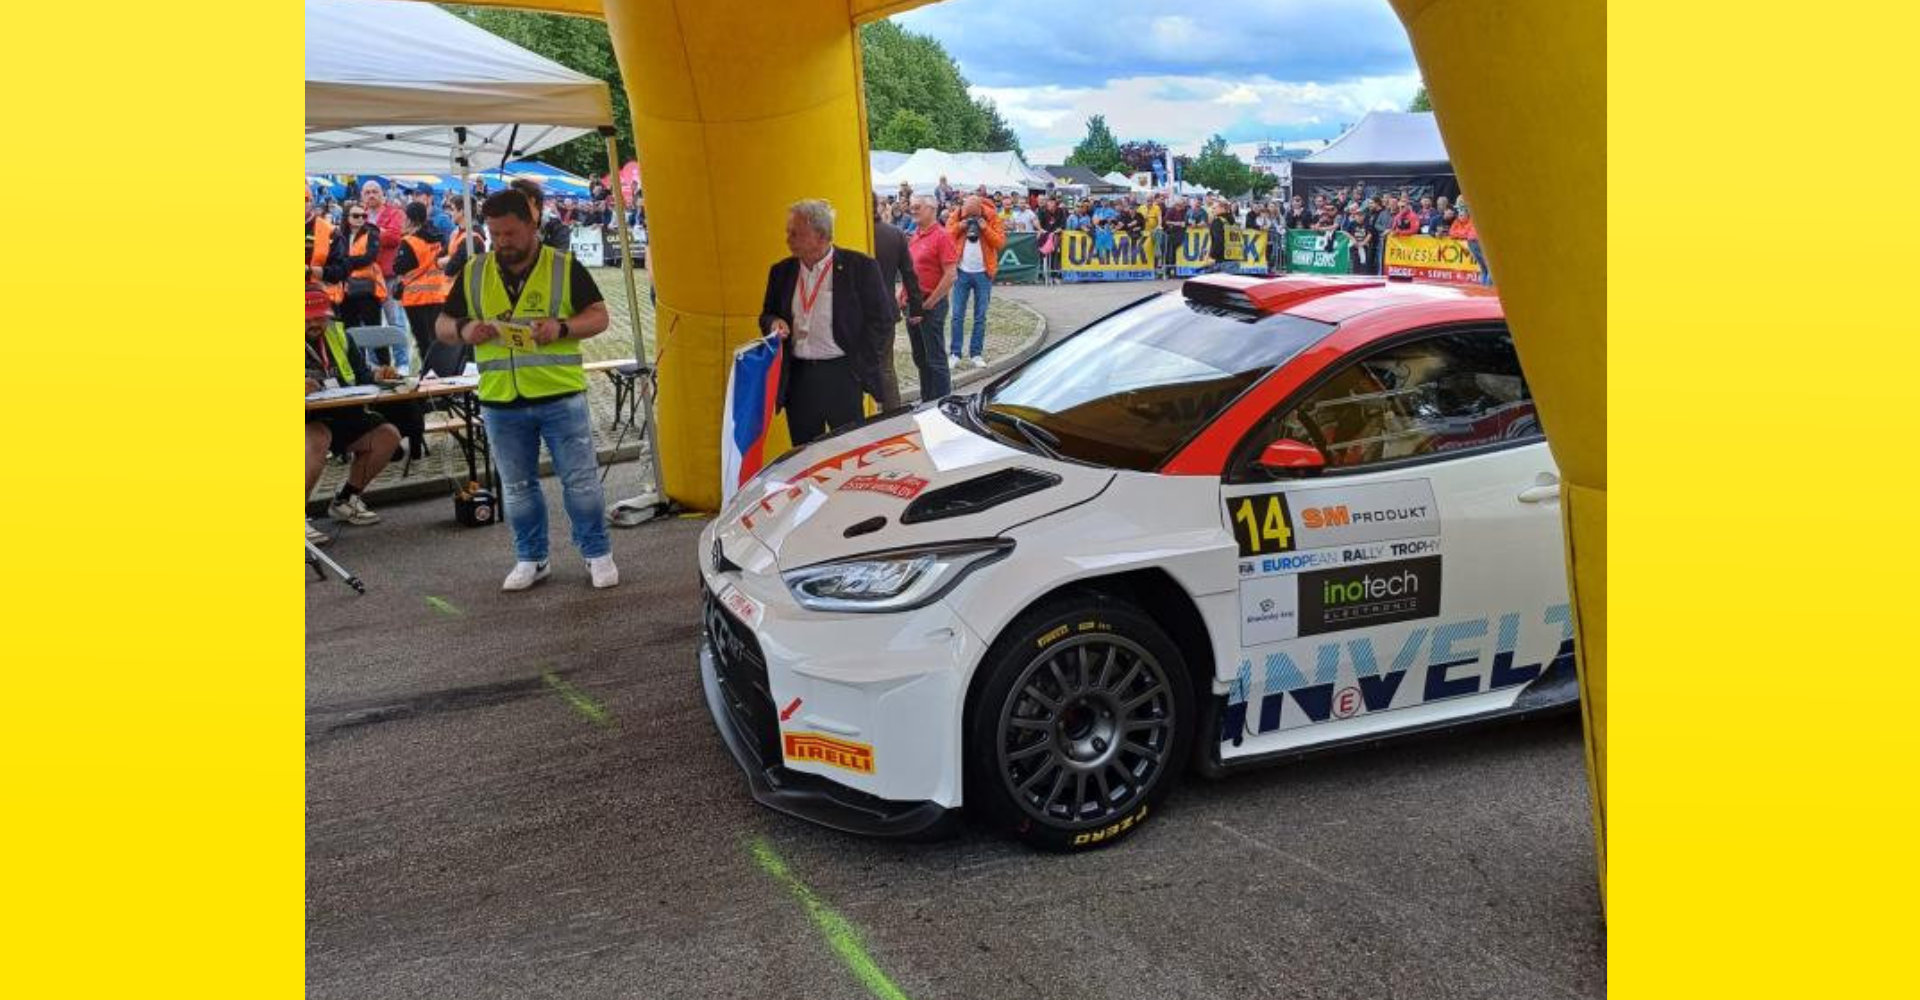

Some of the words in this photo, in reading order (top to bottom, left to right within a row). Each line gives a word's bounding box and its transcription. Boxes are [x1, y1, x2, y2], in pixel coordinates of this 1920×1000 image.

[1068, 233, 1149, 266] UAMK
[1236, 496, 1292, 552] 14
[1301, 505, 1350, 528] SM
[1352, 507, 1427, 524] PRODUKT
[1262, 551, 1338, 573] EUROPEAN
[1343, 545, 1385, 563] RALLY
[1390, 540, 1442, 556] TROPHY
[1323, 570, 1419, 604] inotech
[1339, 692, 1354, 714] E
[784, 733, 875, 774] PIRELLI
